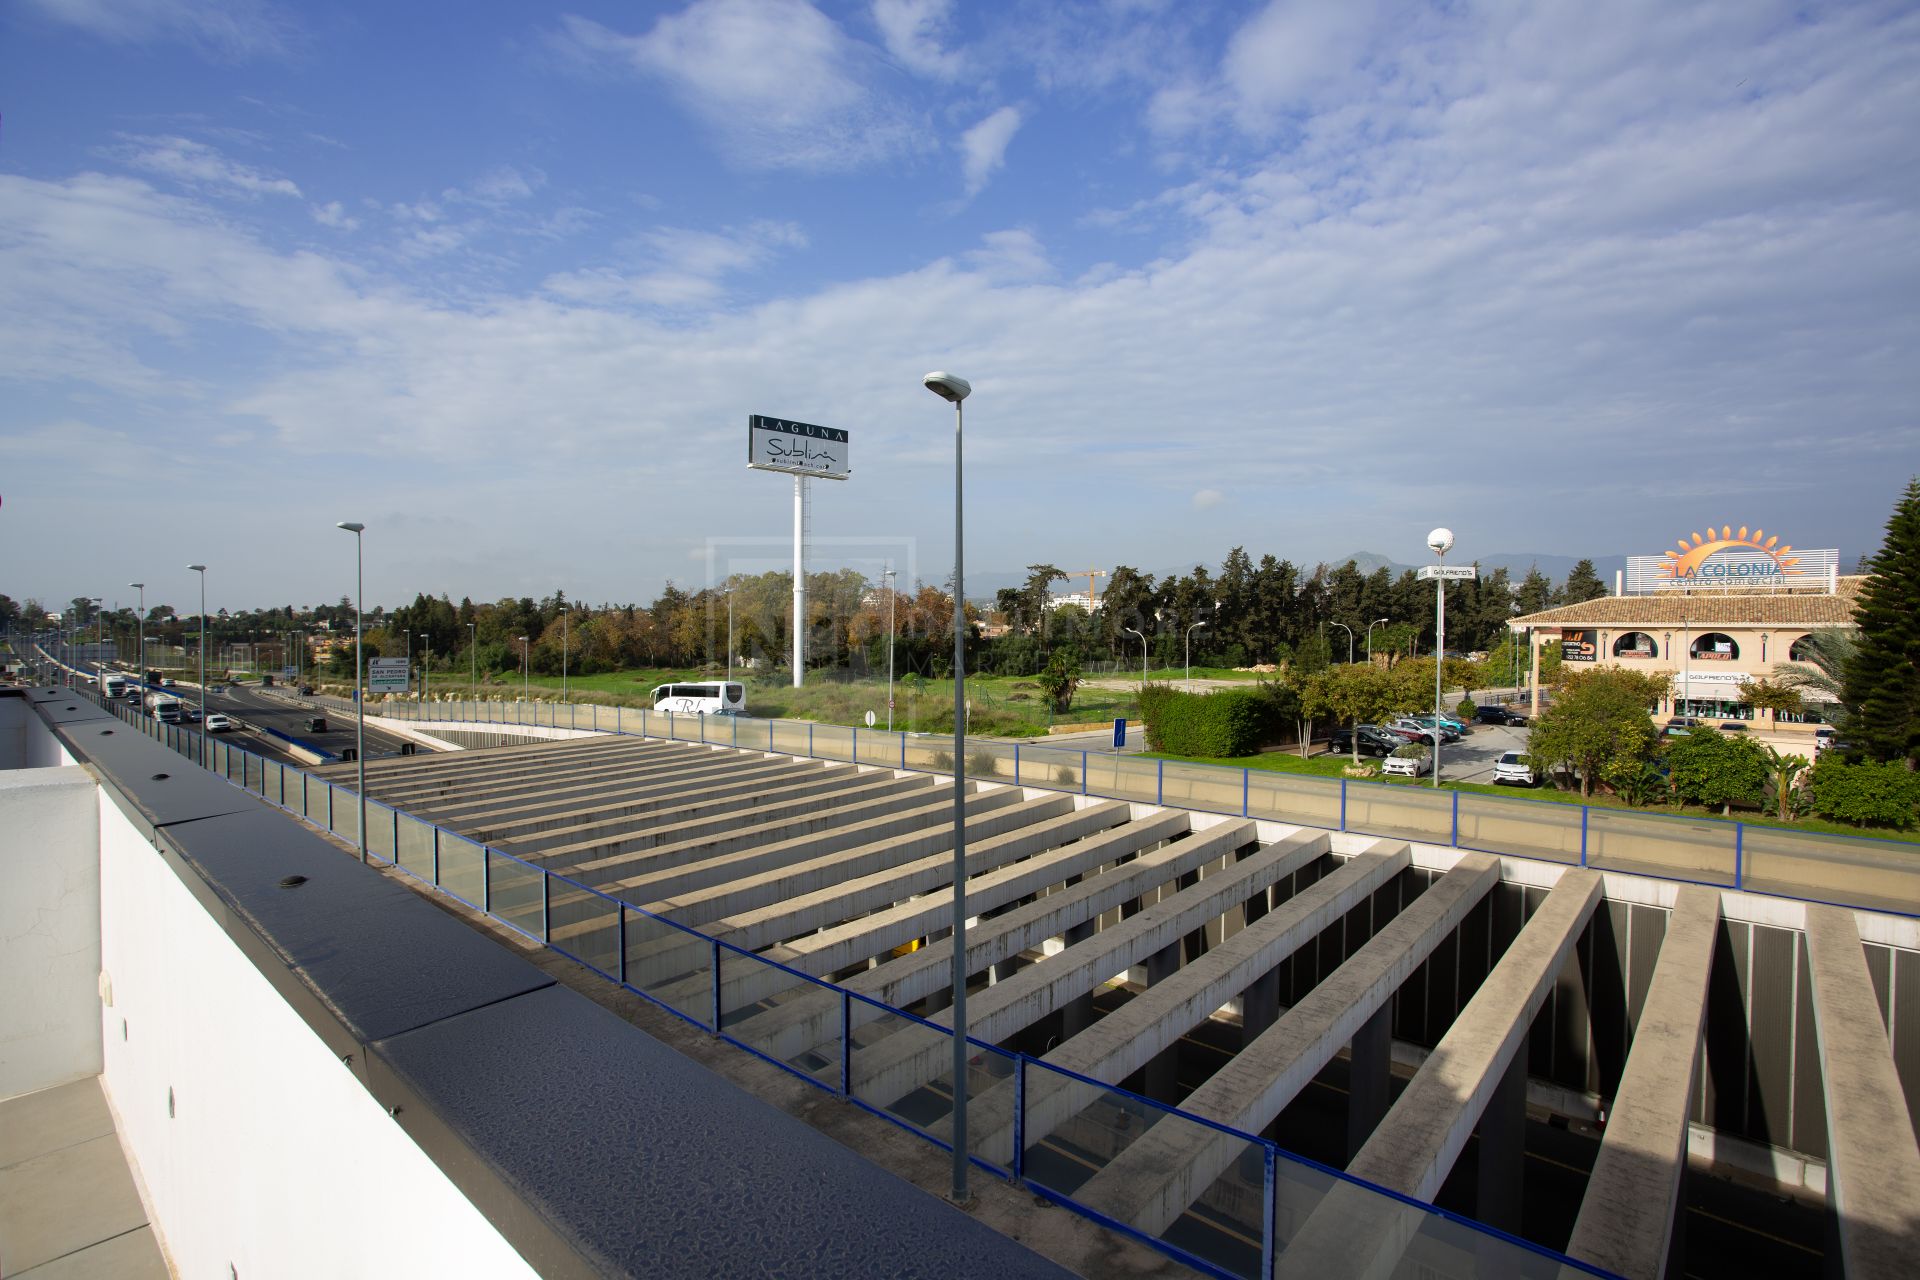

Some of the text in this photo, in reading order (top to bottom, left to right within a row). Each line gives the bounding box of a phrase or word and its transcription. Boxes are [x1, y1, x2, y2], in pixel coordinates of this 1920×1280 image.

[761, 418, 843, 441] LAGUNA
[1675, 563, 1782, 578] LA COLONIA
